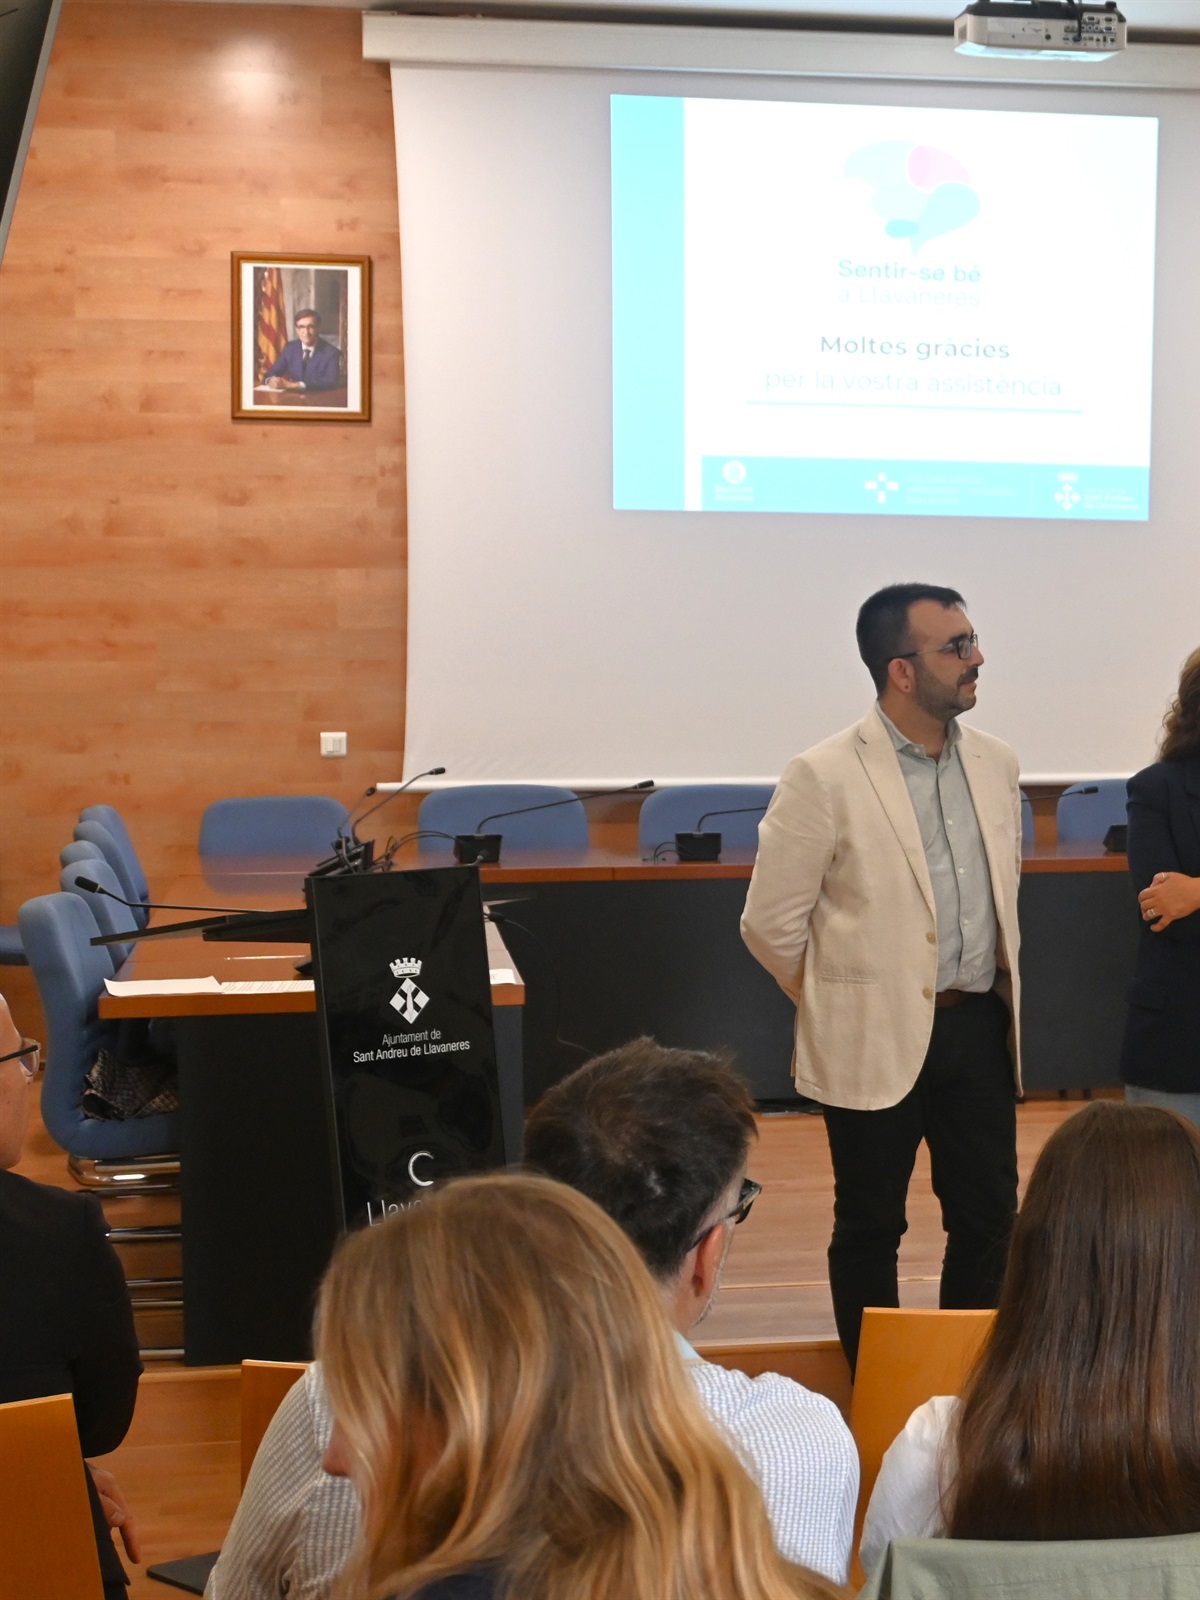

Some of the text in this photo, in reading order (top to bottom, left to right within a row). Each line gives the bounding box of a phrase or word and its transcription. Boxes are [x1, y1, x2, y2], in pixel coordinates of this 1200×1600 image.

[838, 259, 981, 283] Sentir-se bé
[820, 336, 1011, 361] Moltes gràcies
[765, 369, 1062, 397] per la vostra assistència
[382, 1029, 441, 1047] Ajuntament de
[353, 1040, 470, 1063] Sant Andreu de Llavaneres
